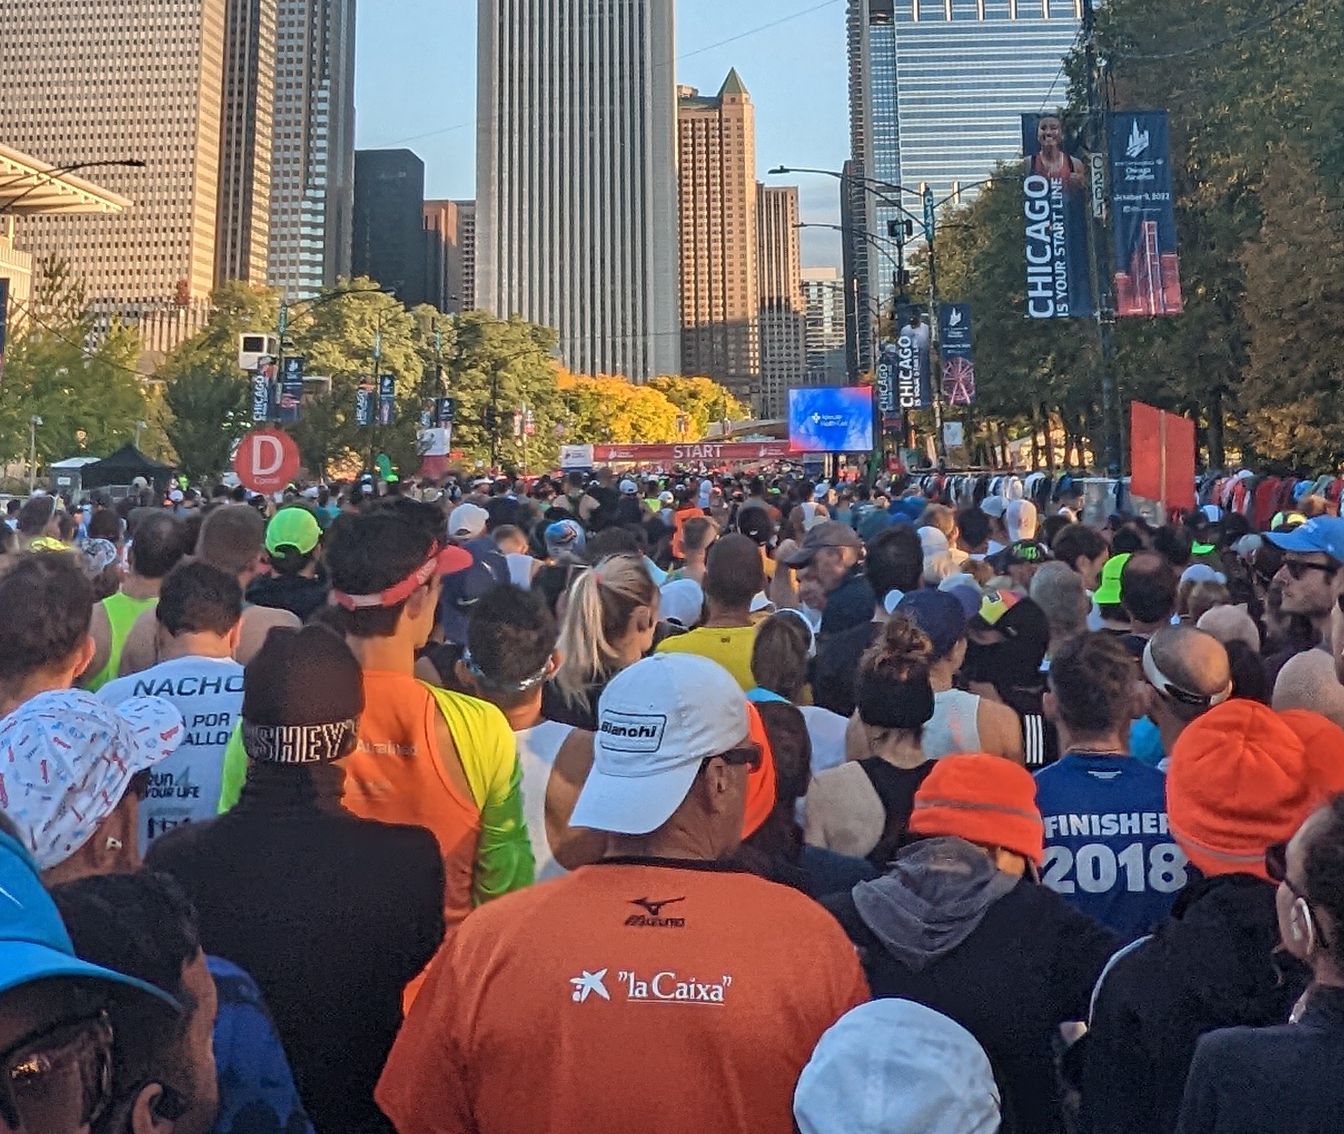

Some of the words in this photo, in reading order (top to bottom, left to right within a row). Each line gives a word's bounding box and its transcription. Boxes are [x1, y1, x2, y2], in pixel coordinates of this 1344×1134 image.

[1051, 177, 1063, 209] LINE
[1023, 174, 1054, 319] CHICAGO
[1052, 212, 1066, 256] START
[1055, 261, 1068, 299] YOUR
[1056, 303, 1069, 317] IS
[898, 335, 914, 407] CHICAGO
[251, 435, 284, 476] D
[673, 444, 724, 460] START
[253, 476, 281, 486] Corral
[192, 713, 230, 728] POR
[600, 721, 657, 738] Bianchi
[1041, 842, 1188, 894] 2018
